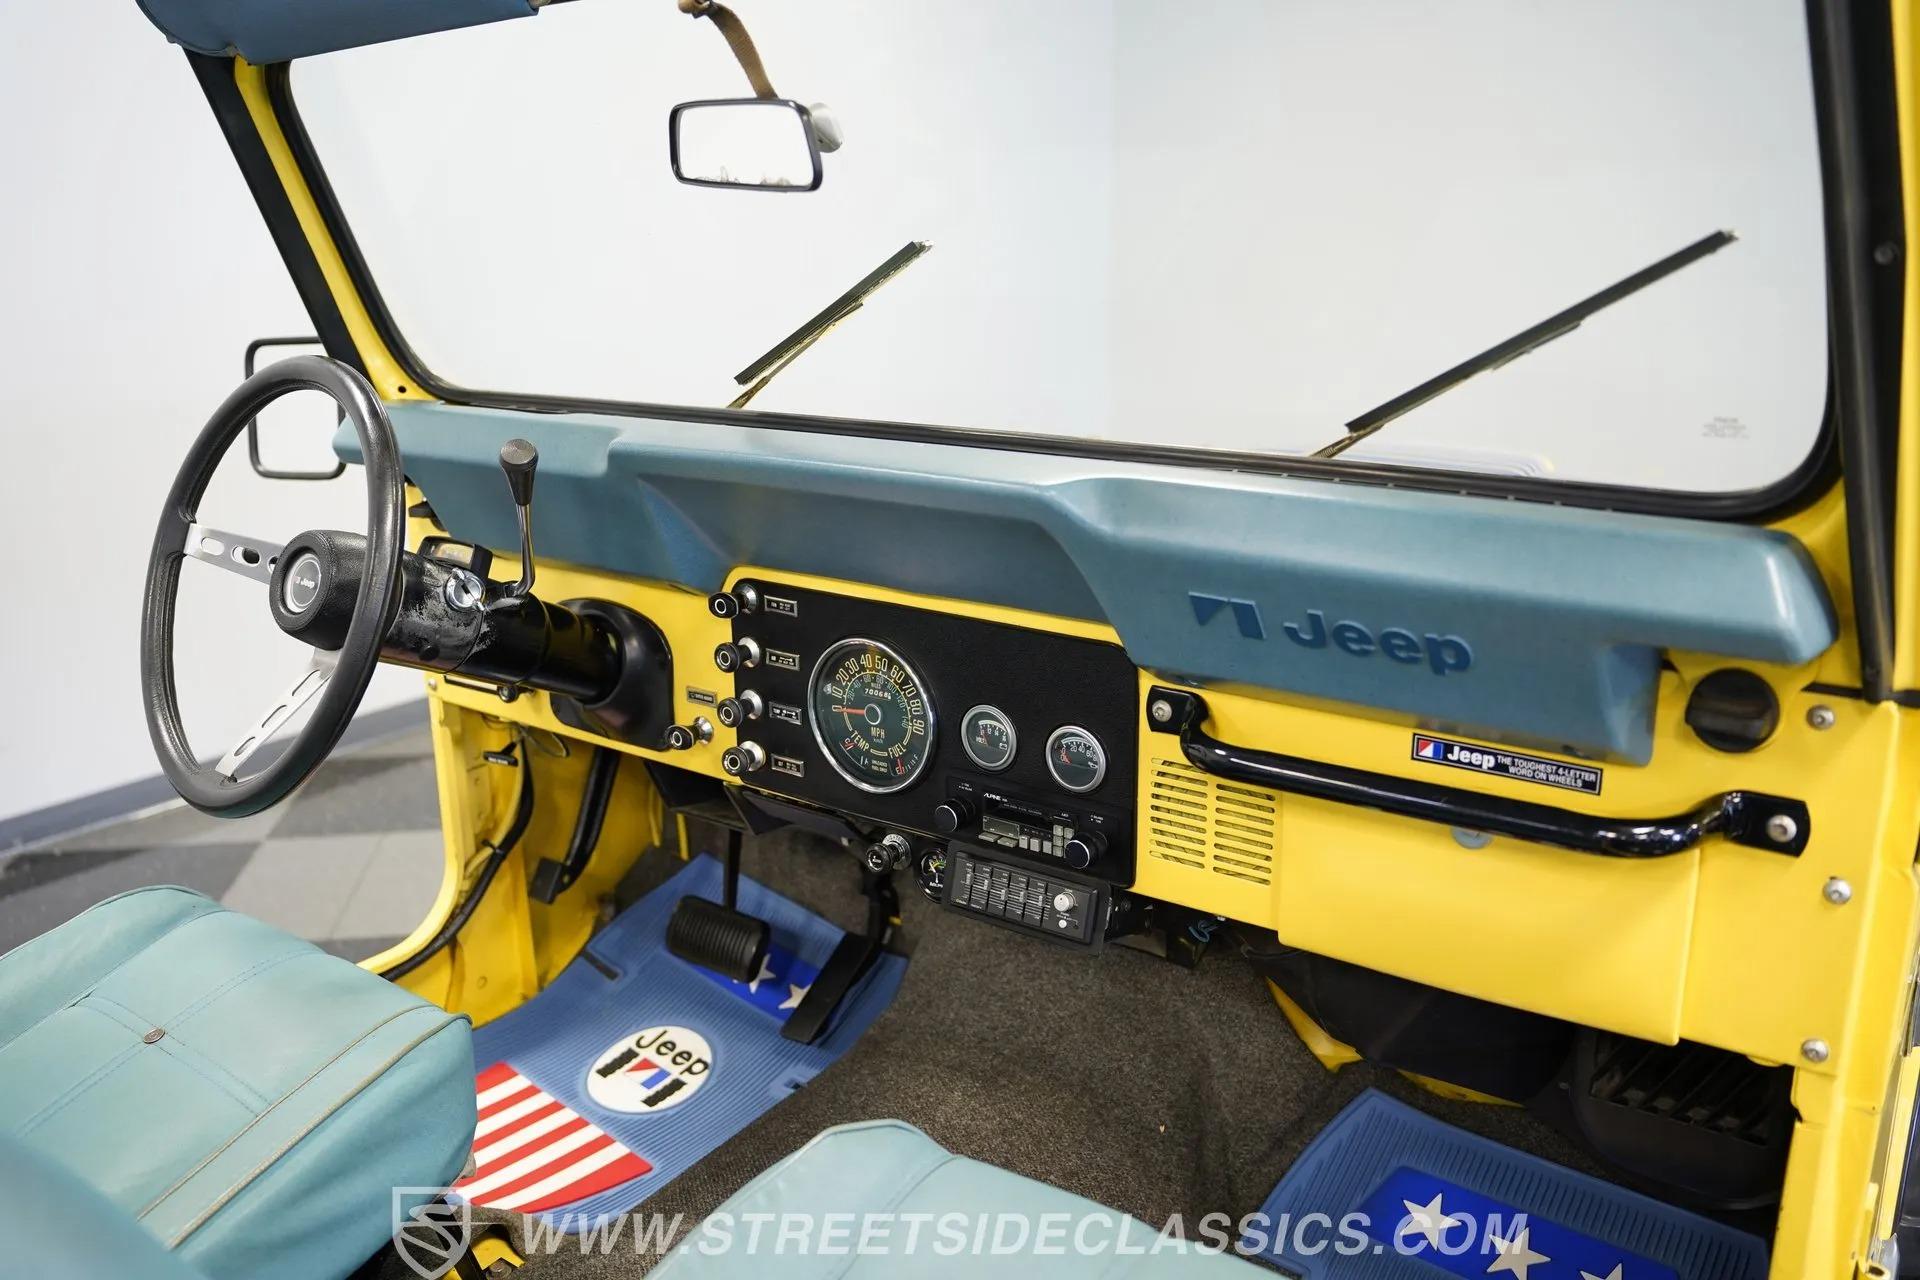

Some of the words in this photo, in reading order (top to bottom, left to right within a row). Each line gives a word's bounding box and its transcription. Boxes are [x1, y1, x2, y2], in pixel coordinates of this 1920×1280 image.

[1283, 608, 1474, 676] Jeep
[845, 657, 859, 673] 30
[860, 653, 872, 668] 40
[875, 655, 888, 672] 50
[836, 668, 849, 685] 20
[890, 664, 905, 683] 60
[832, 685, 843, 699] 10
[902, 680, 917, 697] 70
[909, 699, 923, 715] 80
[871, 726, 885, 739] MPH
[912, 719, 925, 736] 90
[850, 730, 870, 751] TEMP
[888, 742, 907, 759] FUEL
[1447, 746, 1496, 770] Jeep
[1497, 755, 1513, 766] THE
[1514, 758, 1557, 774] TOUGHEST
[1557, 767, 1596, 782] 4-LETTER
[1508, 766, 1534, 778] WORD
[1534, 771, 1548, 781] ON
[1548, 773, 1583, 788] WHEELS
[635, 1030, 709, 1076] Jeep
